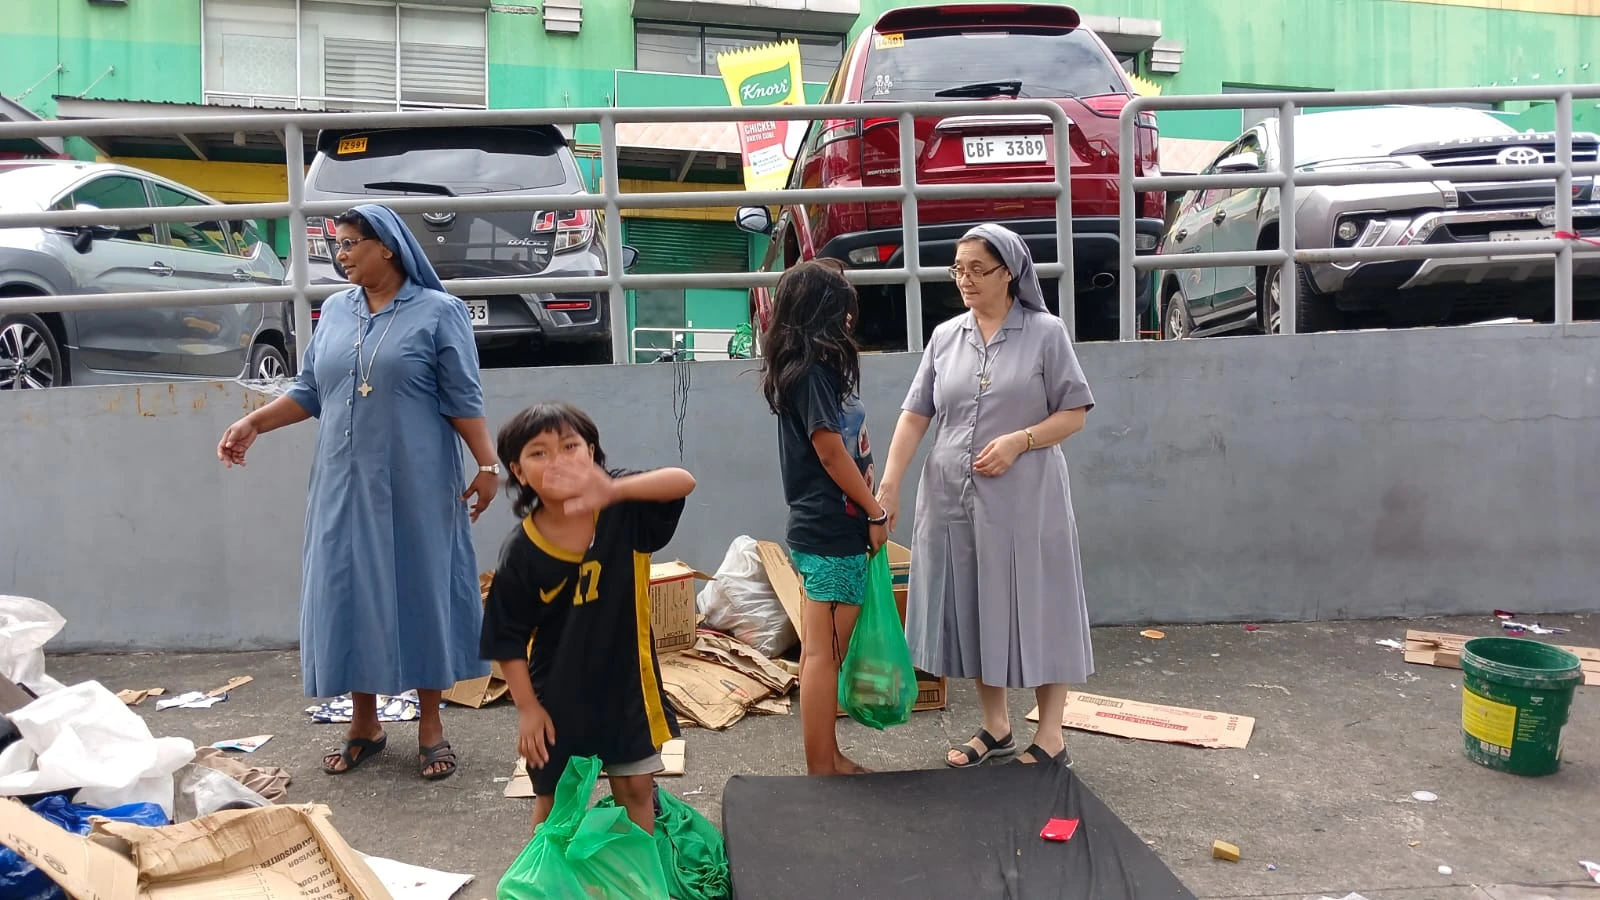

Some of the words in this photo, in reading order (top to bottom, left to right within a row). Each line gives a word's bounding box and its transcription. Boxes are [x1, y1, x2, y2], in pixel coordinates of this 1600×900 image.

[741, 79, 789, 100] Knorr
[744, 120, 776, 135] CHICKEN
[966, 142, 995, 158] CBF
[1005, 140, 1044, 156] 3389
[470, 306, 486, 320] 33
[573, 560, 601, 605] 17
